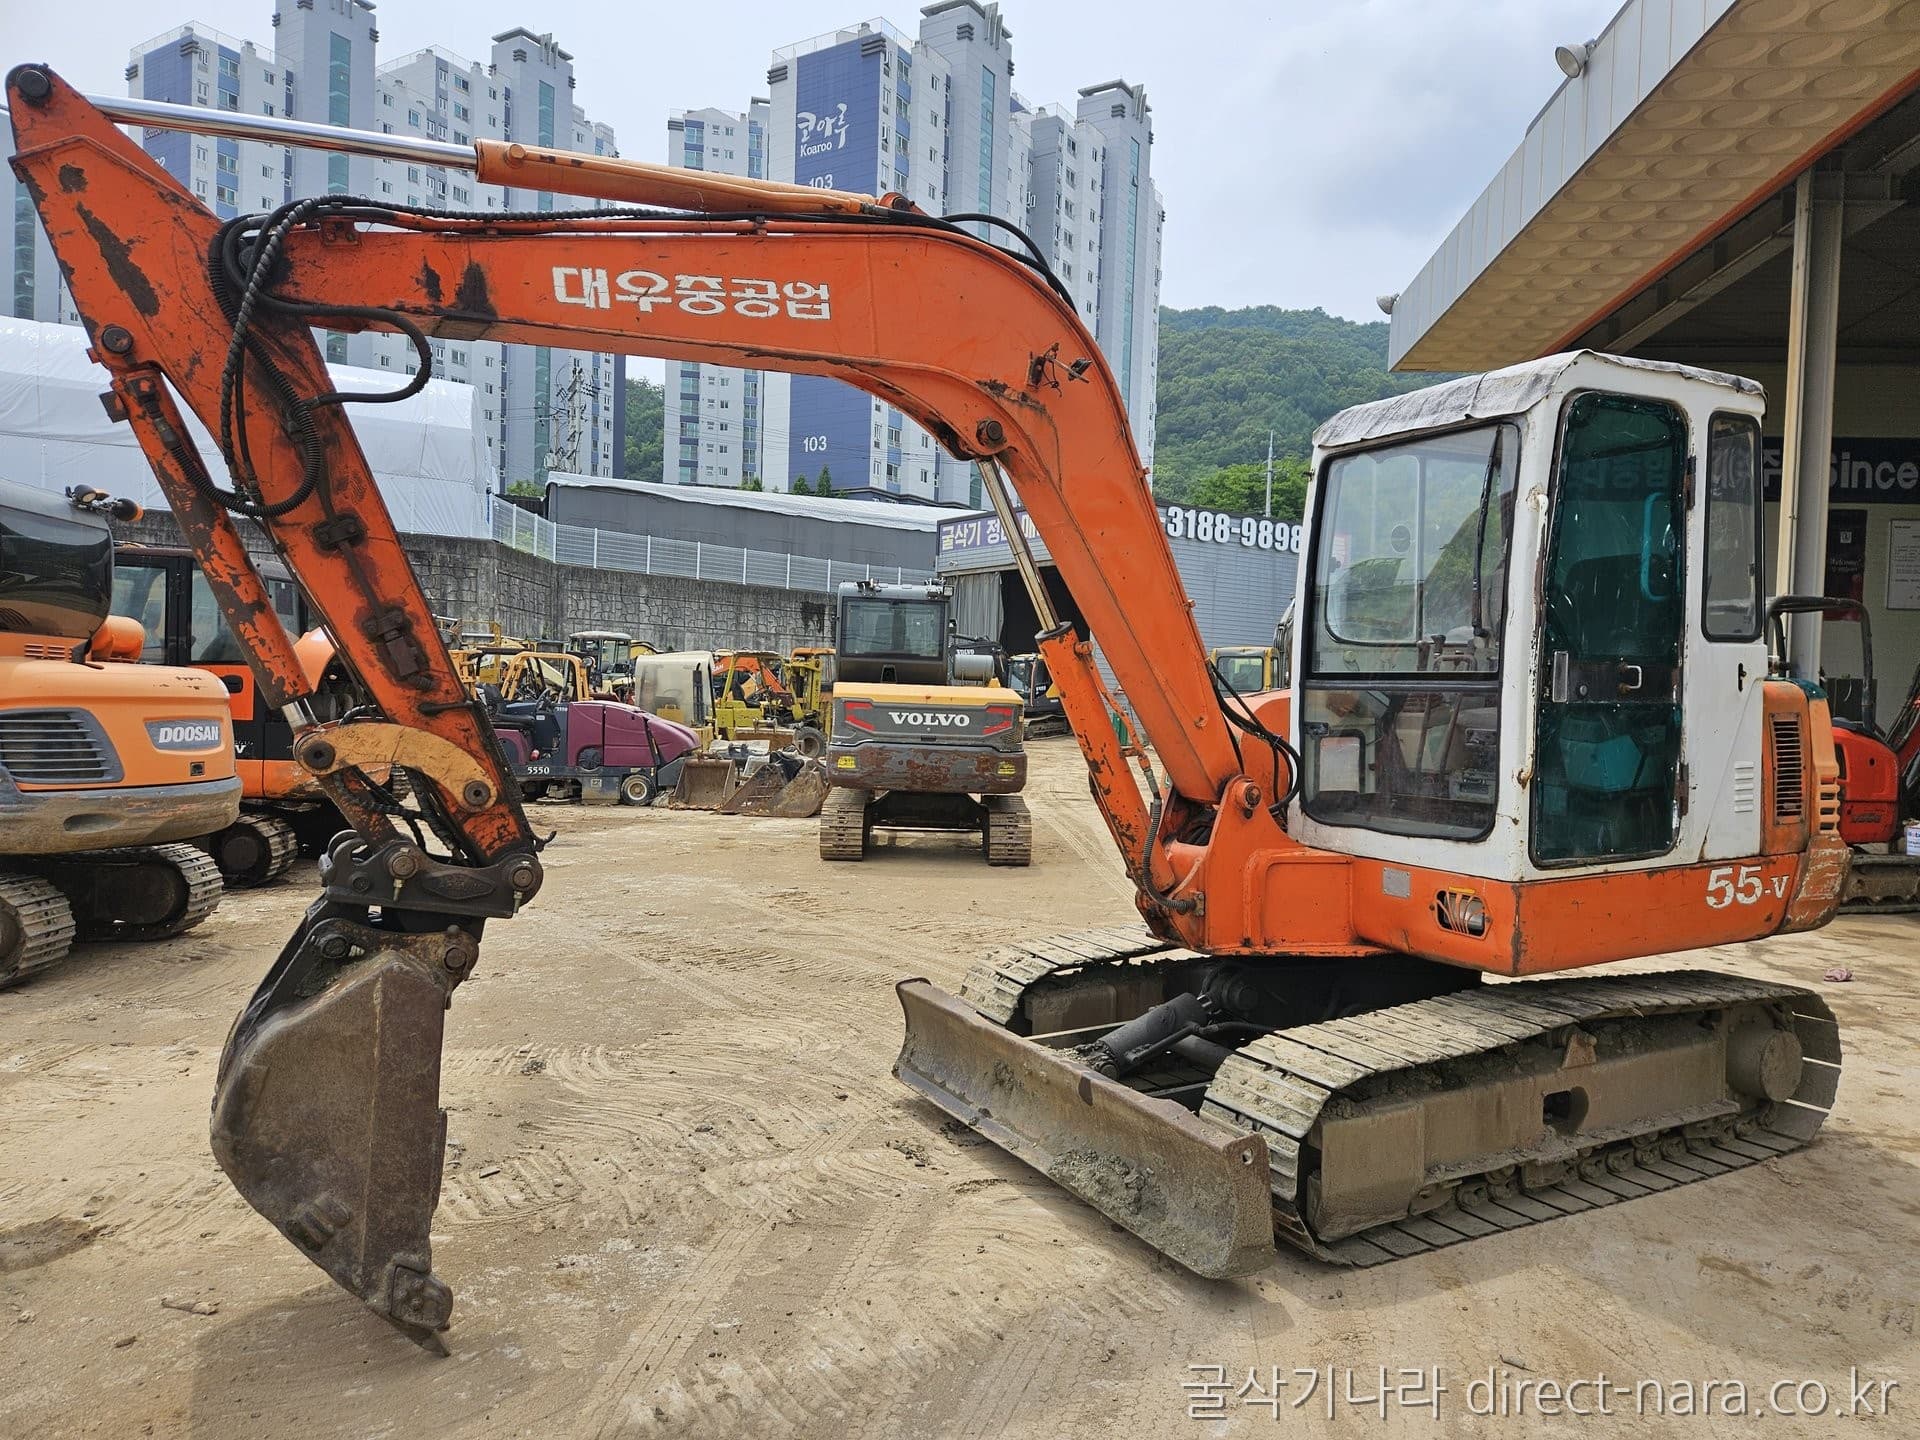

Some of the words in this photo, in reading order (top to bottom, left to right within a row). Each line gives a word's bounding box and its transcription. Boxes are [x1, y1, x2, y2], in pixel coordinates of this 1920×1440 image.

[800, 141, 833, 157] Koaroo
[552, 266, 831, 320] 대우중공업
[803, 435, 827, 453] 103
[942, 521, 981, 551] 굴삭기
[888, 712, 970, 727] VOLVO
[158, 726, 219, 743] DOOSAN
[527, 766, 550, 775] 5550
